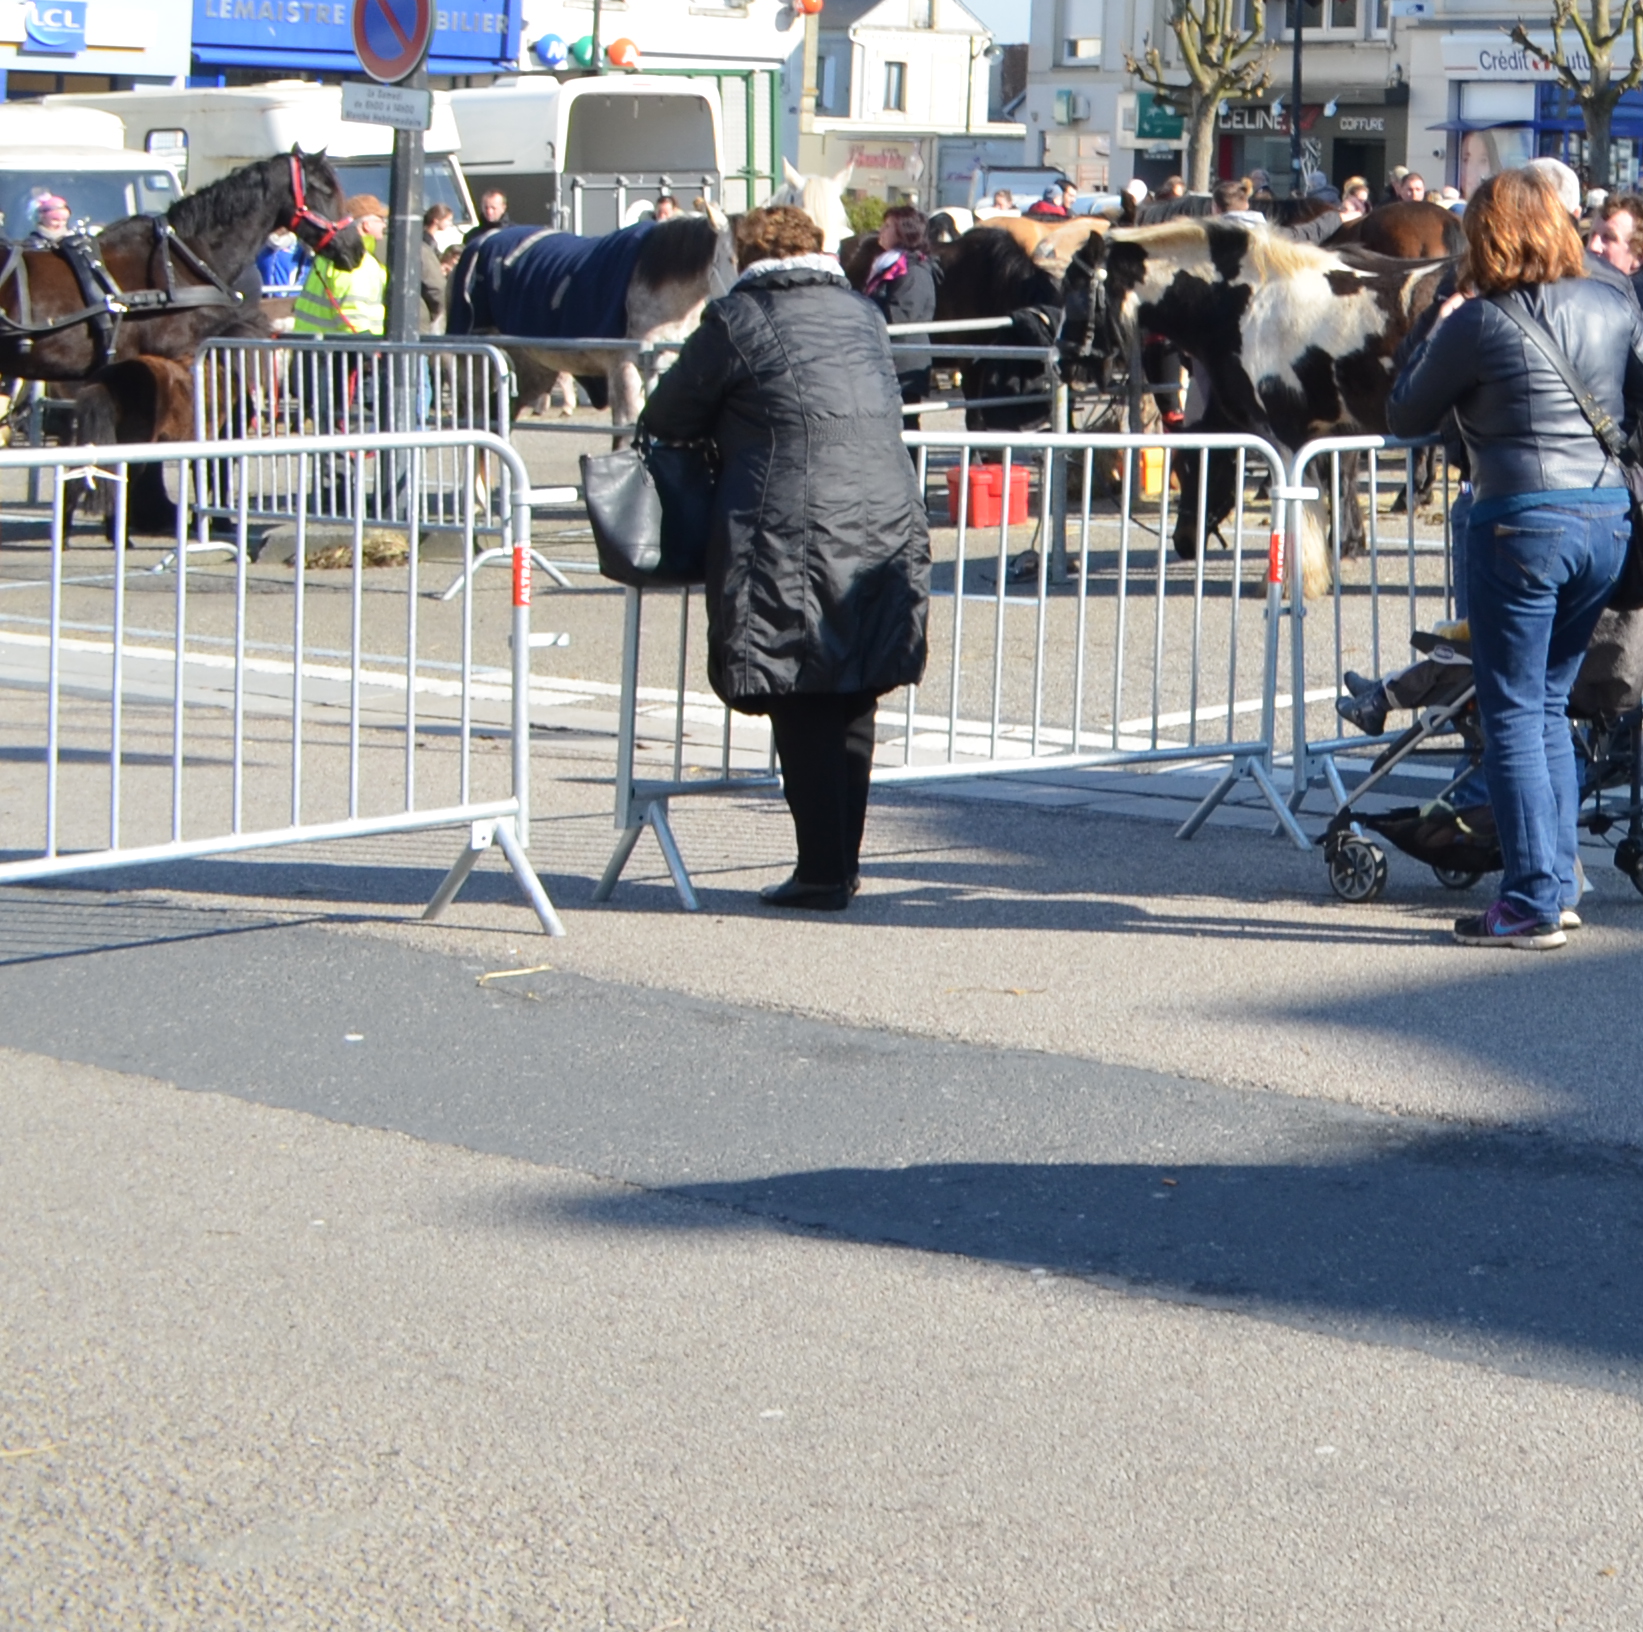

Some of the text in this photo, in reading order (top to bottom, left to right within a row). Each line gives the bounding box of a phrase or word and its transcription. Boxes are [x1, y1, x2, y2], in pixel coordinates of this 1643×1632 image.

[31, 8, 80, 28] LCL
[436, 12, 509, 35] BILIER
[1479, 50, 1529, 71] Crédit
[1339, 117, 1385, 131] COIFFURE
[519, 547, 531, 605] ALTRAD
